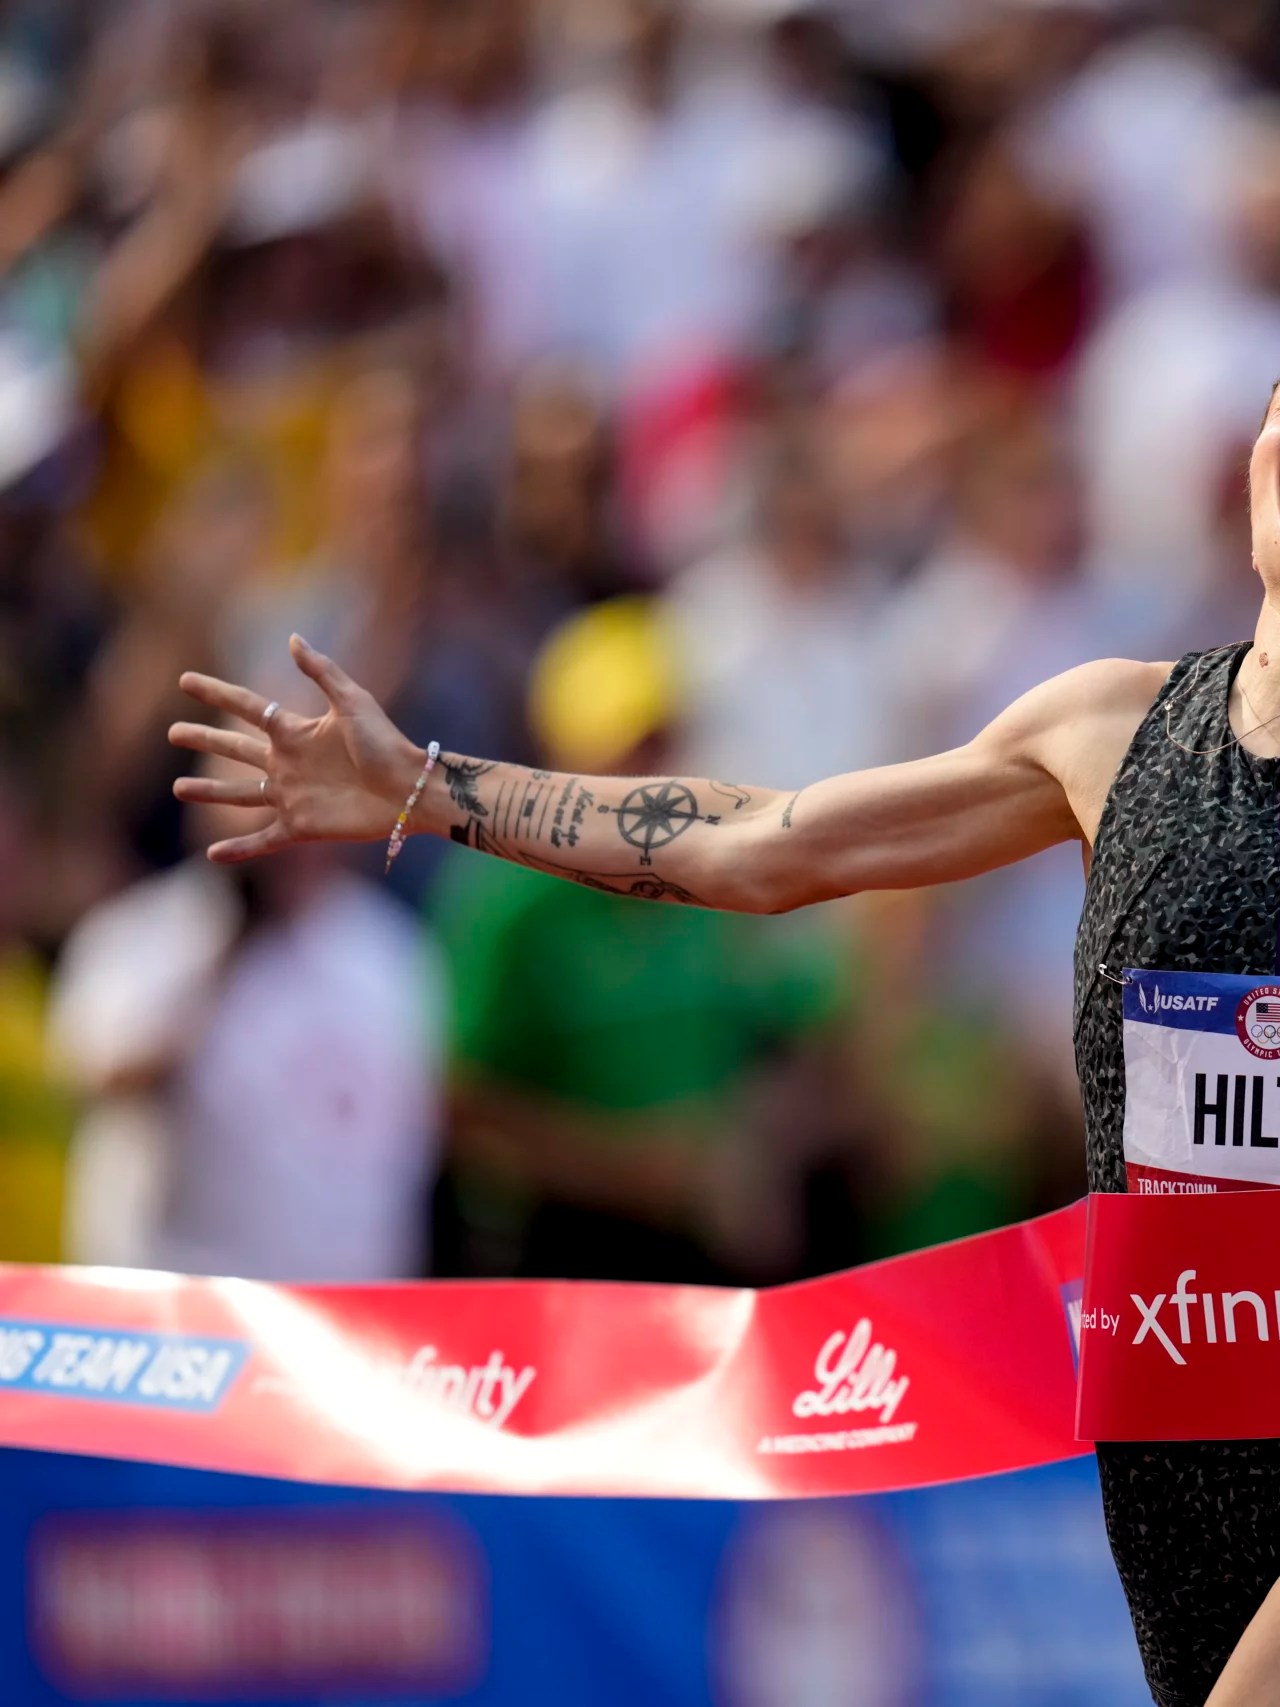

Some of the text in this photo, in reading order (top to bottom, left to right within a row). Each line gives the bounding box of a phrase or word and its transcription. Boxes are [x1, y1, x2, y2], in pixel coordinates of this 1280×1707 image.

[1160, 995, 1219, 1011] USATF
[1243, 987, 1269, 1006] UNITED
[1243, 1038, 1273, 1058] OLYMPIC
[1101, 1308, 1120, 1336] by
[32, 1333, 150, 1394] TEAM
[138, 1345, 232, 1402] USA
[793, 1318, 910, 1424] Lilly
